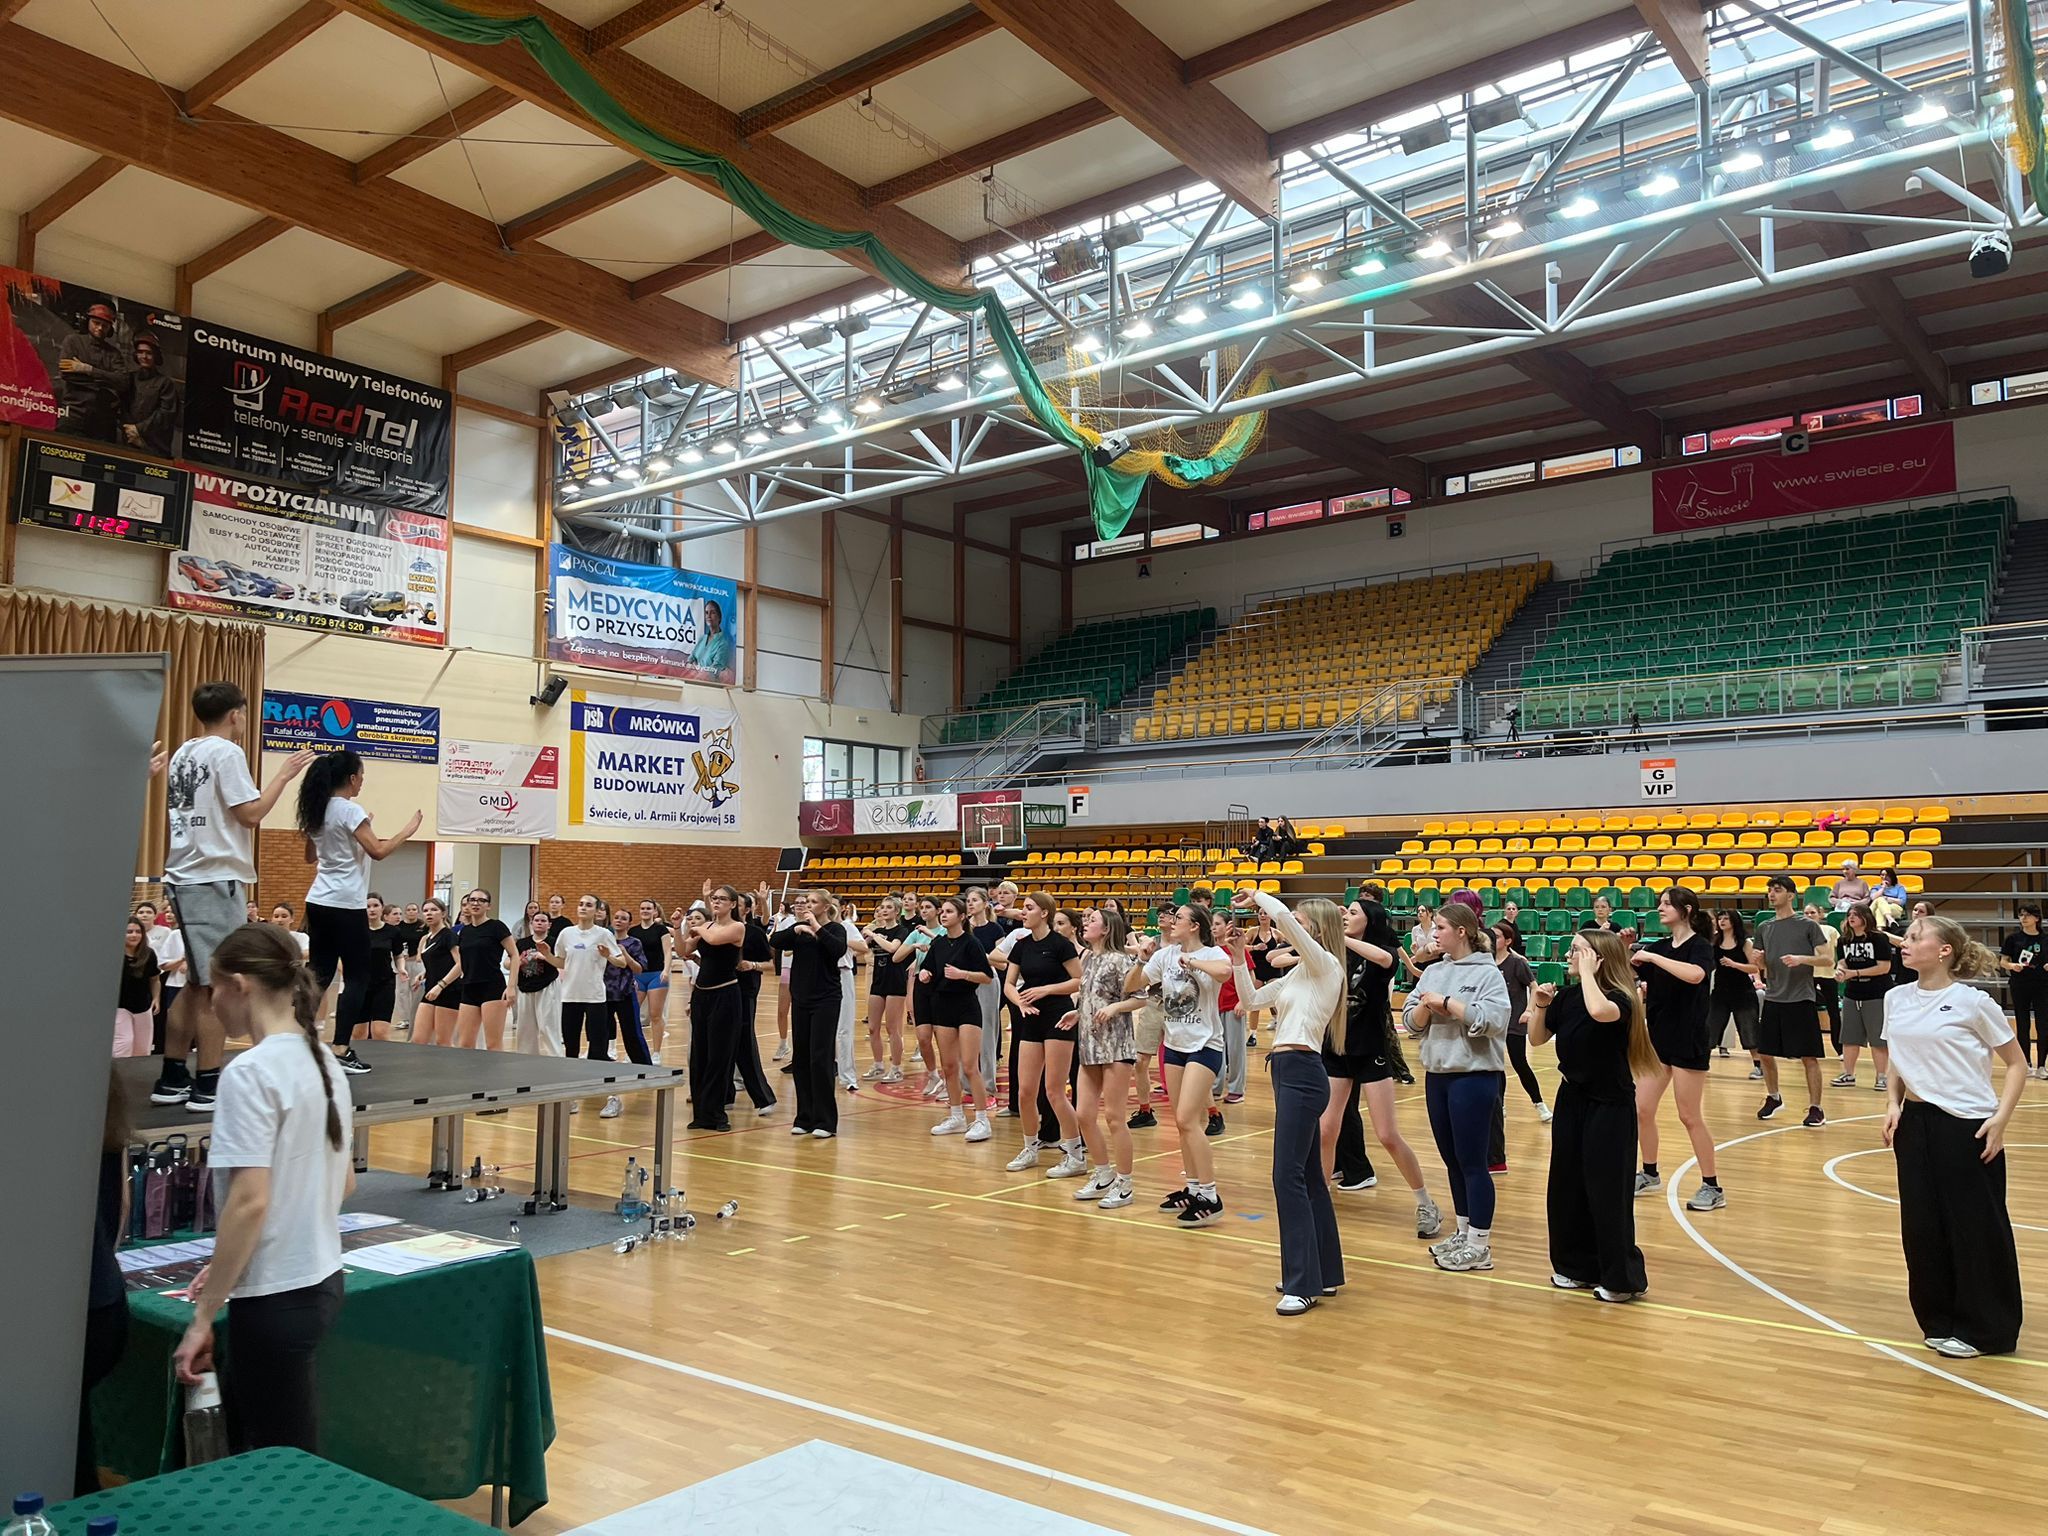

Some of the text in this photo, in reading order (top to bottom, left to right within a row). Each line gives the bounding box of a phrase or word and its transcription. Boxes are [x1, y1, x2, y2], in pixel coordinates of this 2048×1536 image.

[153, 318, 183, 331] mondi
[193, 328, 443, 410] Centrum Naprawy Telefonów
[0, 395, 70, 418] ondijobs.pl
[278, 386, 419, 450] RedTel
[233, 409, 290, 438] telefony
[300, 426, 345, 448] serwis
[354, 440, 414, 465] akcesoria
[1786, 434, 1804, 452] C
[40, 445, 87, 463] GOSPODARZE
[144, 466, 169, 480] GOŚCIE
[1772, 457, 1926, 490] www.swiecie.eu
[195, 473, 377, 525] WYPOŻYCZALNIA
[1695, 498, 1751, 520] Świecie
[74, 513, 130, 535] 11:22
[203, 509, 301, 535] SAMOCHODY OSOBOWE
[1389, 522, 1403, 538] B
[208, 528, 233, 539] BUSY
[258, 537, 301, 550] OSOBOWE
[251, 527, 301, 542] DOSTAWCZE
[244, 543, 301, 558] AUTOLAWETY
[346, 537, 393, 553] OGRODNICZY
[346, 545, 392, 559] BUDOWLANY
[265, 555, 301, 566] KAMPER
[315, 548, 363, 561] MINIKOPARKI
[251, 560, 300, 573] PRZYCZEPY
[344, 561, 382, 573] DROGOWA
[572, 556, 618, 578] PASCAL
[1138, 564, 1150, 578] A
[314, 571, 335, 581] AUTO
[196, 600, 235, 612] PARKOWA
[567, 587, 697, 627] MEDYCYNA
[309, 615, 327, 626] 729
[328, 618, 345, 629] 874
[347, 621, 365, 632] 520
[567, 613, 697, 645] TO PRZYSZŁOŚĆ!
[570, 642, 597, 656] Zapisz
[597, 645, 608, 659] się
[609, 650, 620, 658] na
[622, 649, 659, 666] bezpłatny
[263, 701, 319, 722] RAF
[373, 707, 422, 718] spawalnictwo
[356, 723, 390, 732] armatura
[375, 716, 420, 727] pneumatyka
[583, 706, 696, 737] psb MRÓWKA
[390, 735, 433, 744] skrawaniem
[597, 750, 685, 776] MARKET
[1652, 769, 1665, 780] G
[593, 777, 685, 796] BUDOWLANY
[1644, 784, 1674, 796] VIP
[479, 795, 510, 807] GMD
[1072, 796, 1085, 814] F
[589, 803, 736, 826] Świecie, ul. Armii Krajowej 5B
[871, 800, 909, 826] eko
[1184, 1013, 1202, 1025] life
